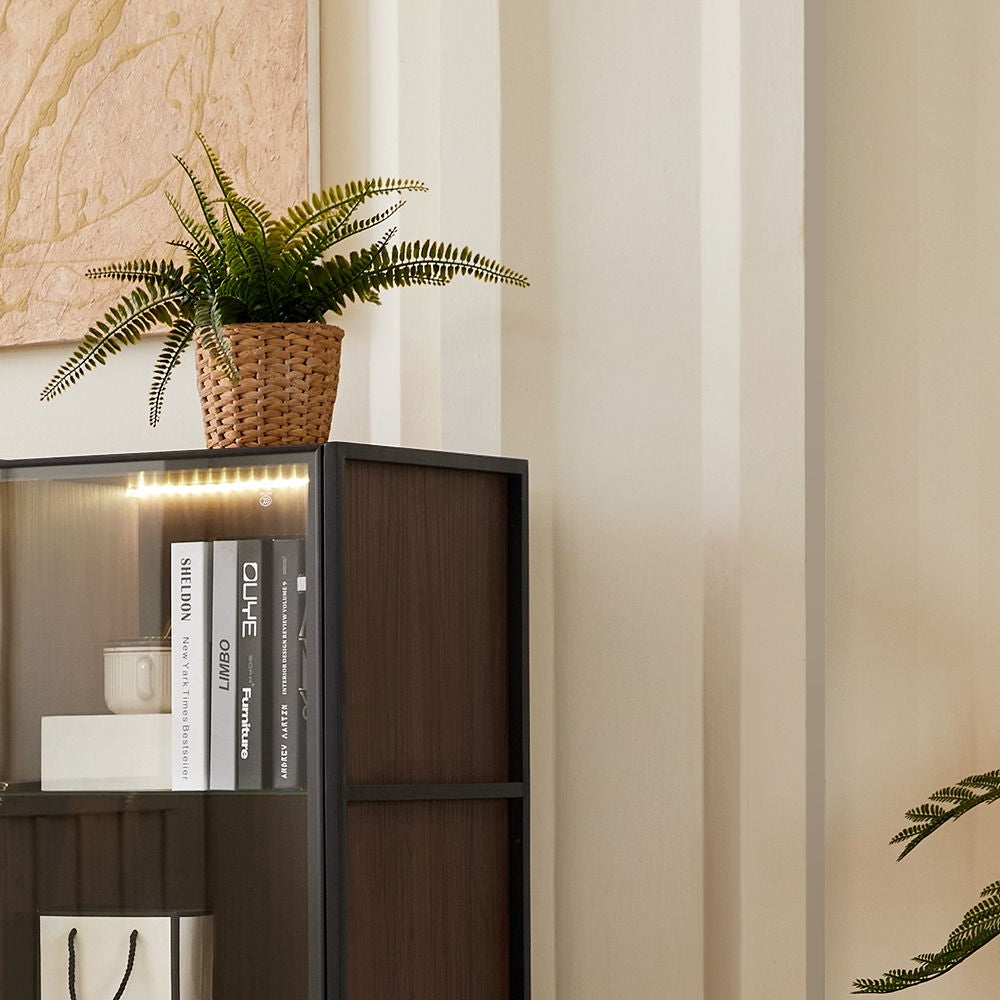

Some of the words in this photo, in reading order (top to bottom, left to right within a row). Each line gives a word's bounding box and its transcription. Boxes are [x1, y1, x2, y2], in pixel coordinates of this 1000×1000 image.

[180, 557, 192, 622] SHELDON
[242, 562, 258, 638] OUYE
[182, 636, 190, 660] New
[218, 639, 231, 692] LIMBO
[182, 689, 190, 723] Times
[240, 687, 252, 760] Furniture
